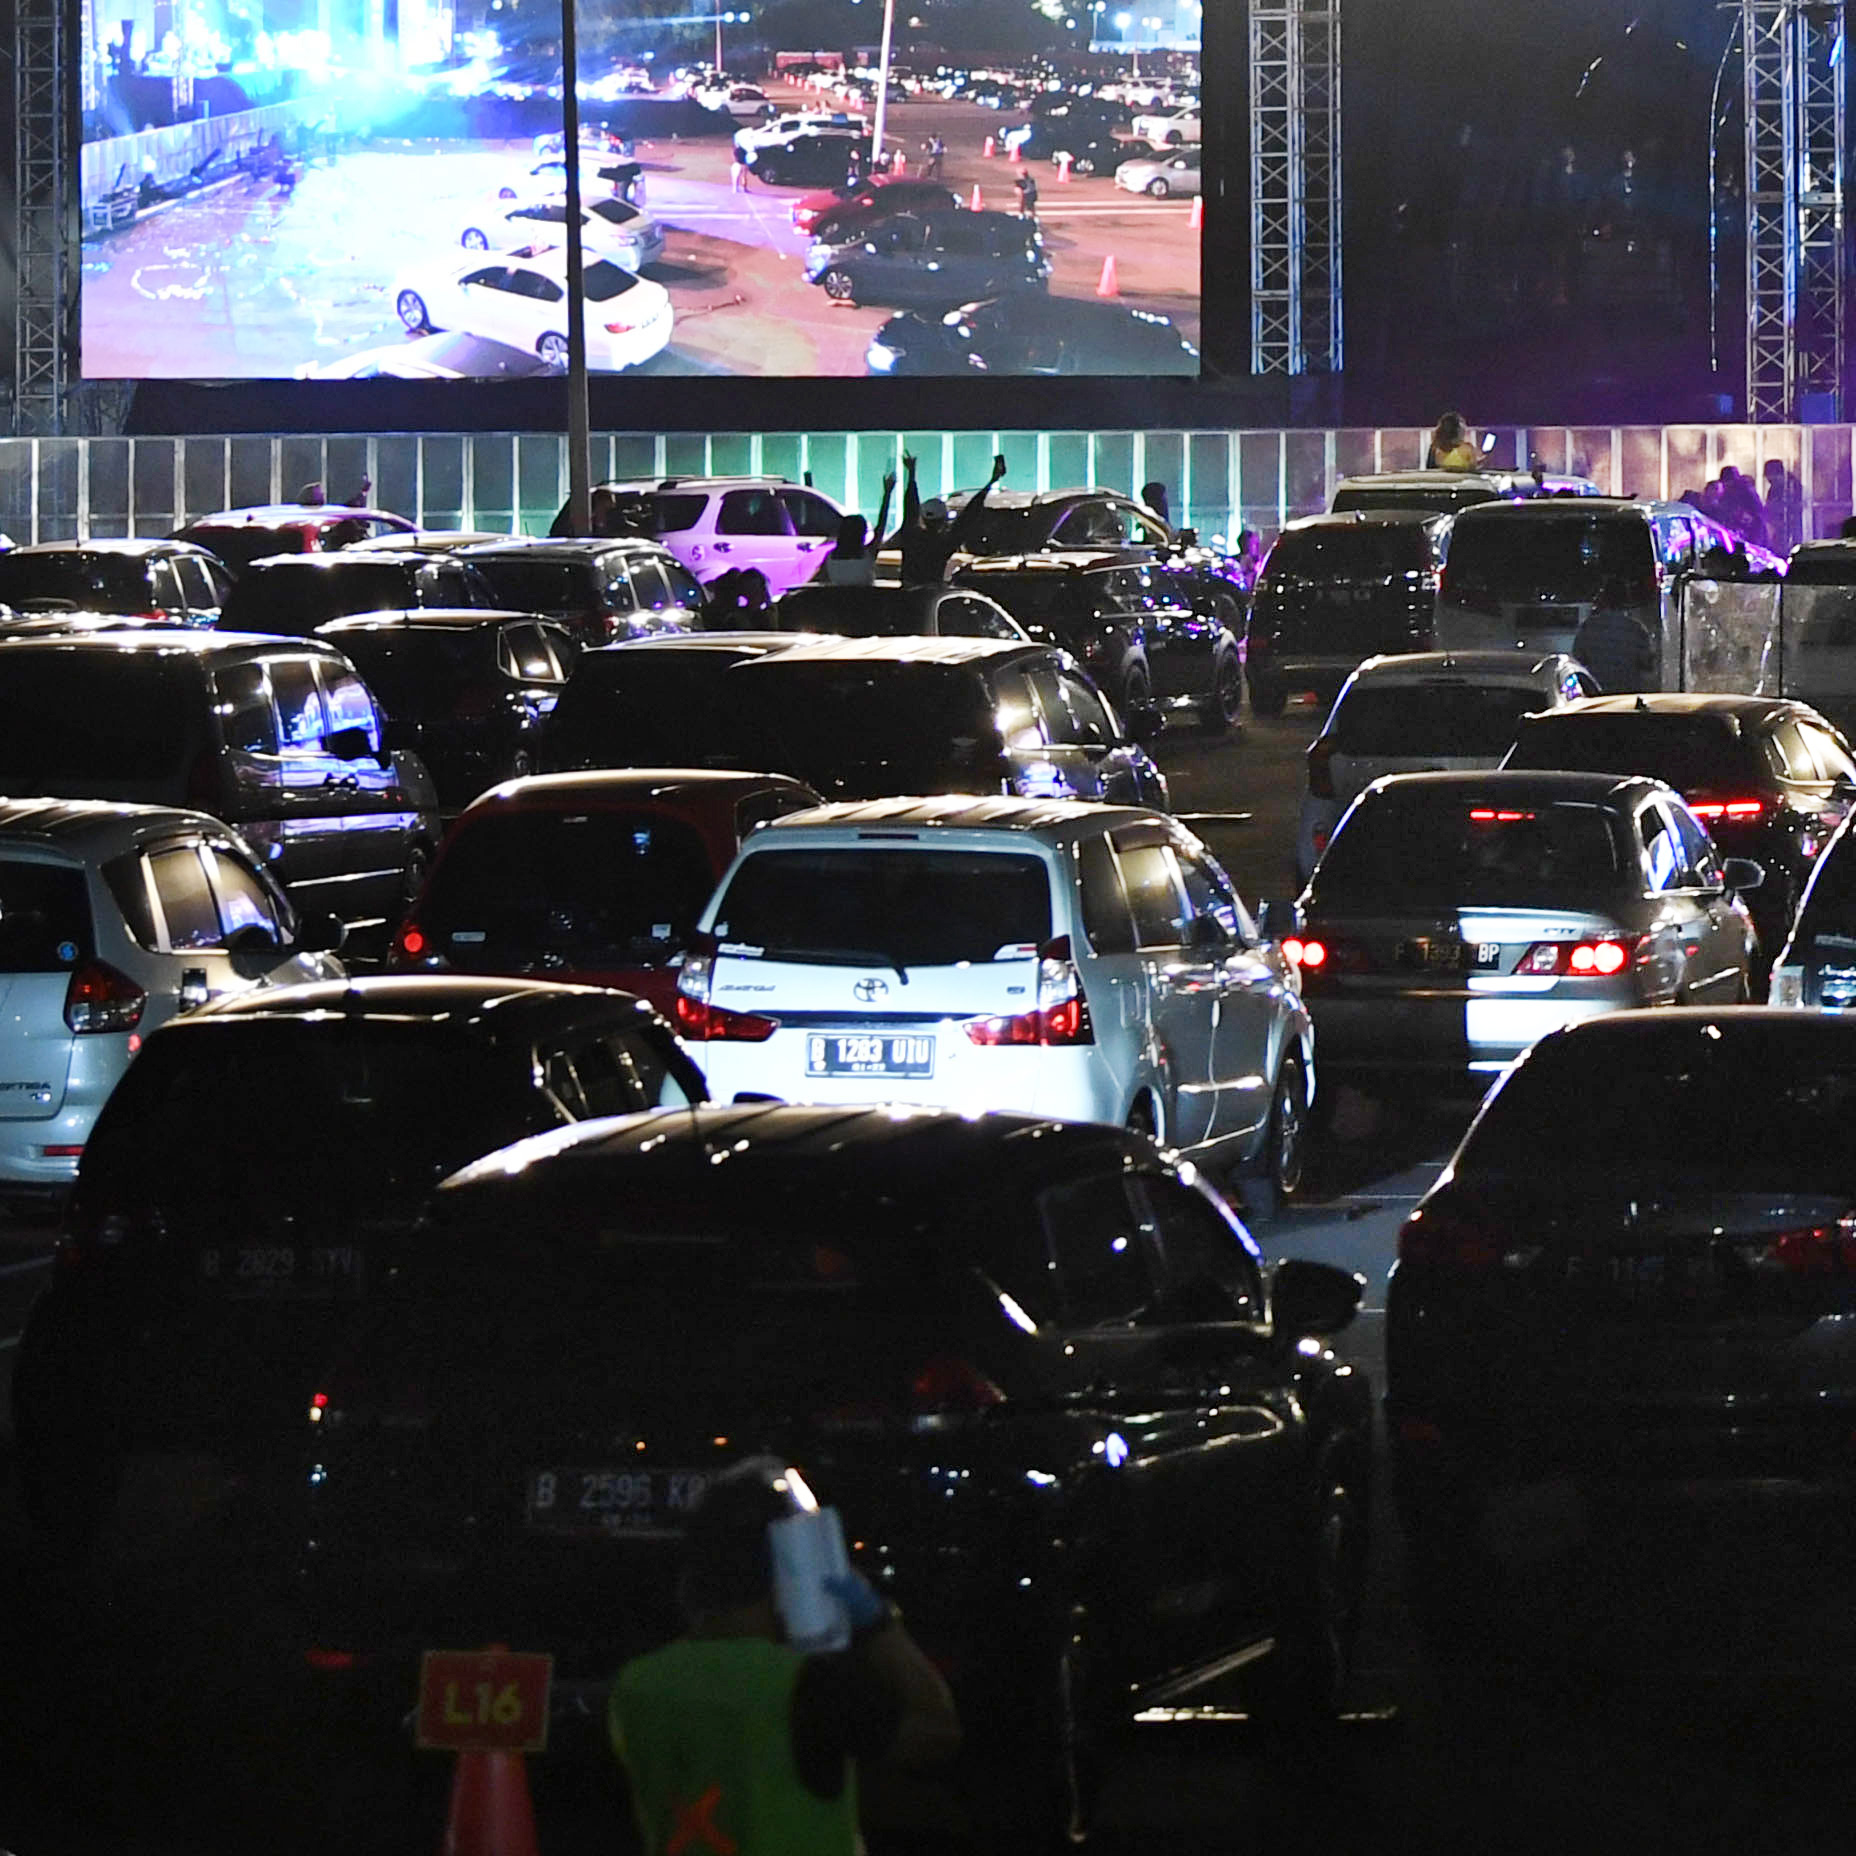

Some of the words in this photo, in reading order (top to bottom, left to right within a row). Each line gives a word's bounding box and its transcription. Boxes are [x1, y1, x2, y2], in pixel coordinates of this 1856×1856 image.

[1477, 943, 1500, 963] BP
[811, 1038, 826, 1062] B
[838, 1038, 883, 1063] 1283
[892, 1038, 930, 1064] UIU
[444, 1681, 523, 1725] L16
